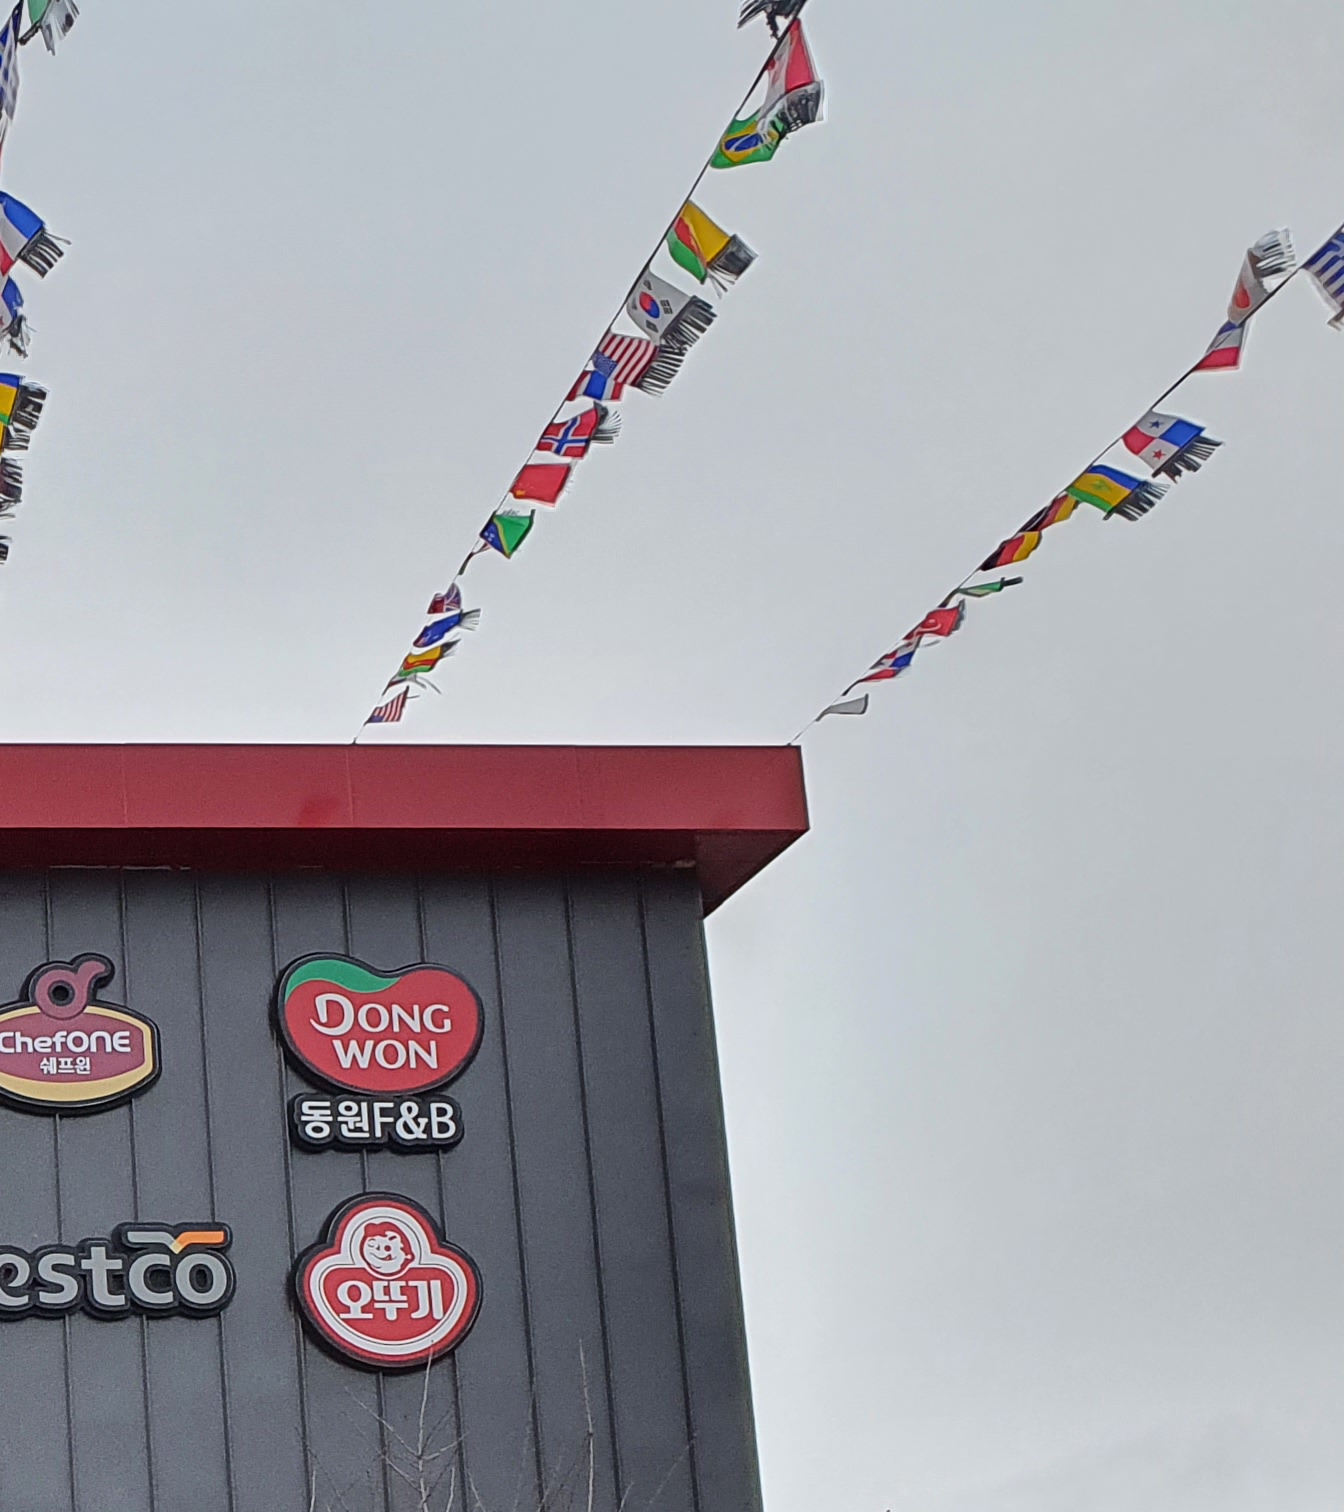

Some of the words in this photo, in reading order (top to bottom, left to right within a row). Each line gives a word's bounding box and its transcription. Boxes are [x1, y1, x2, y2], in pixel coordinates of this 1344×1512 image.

[310, 993, 452, 1036] DONG
[40, 1057, 91, 1075] 쉐프원
[333, 1039, 439, 1071] WON
[299, 1101, 457, 1141] 동원F&B
[337, 1282, 446, 1323] 오뚜기
